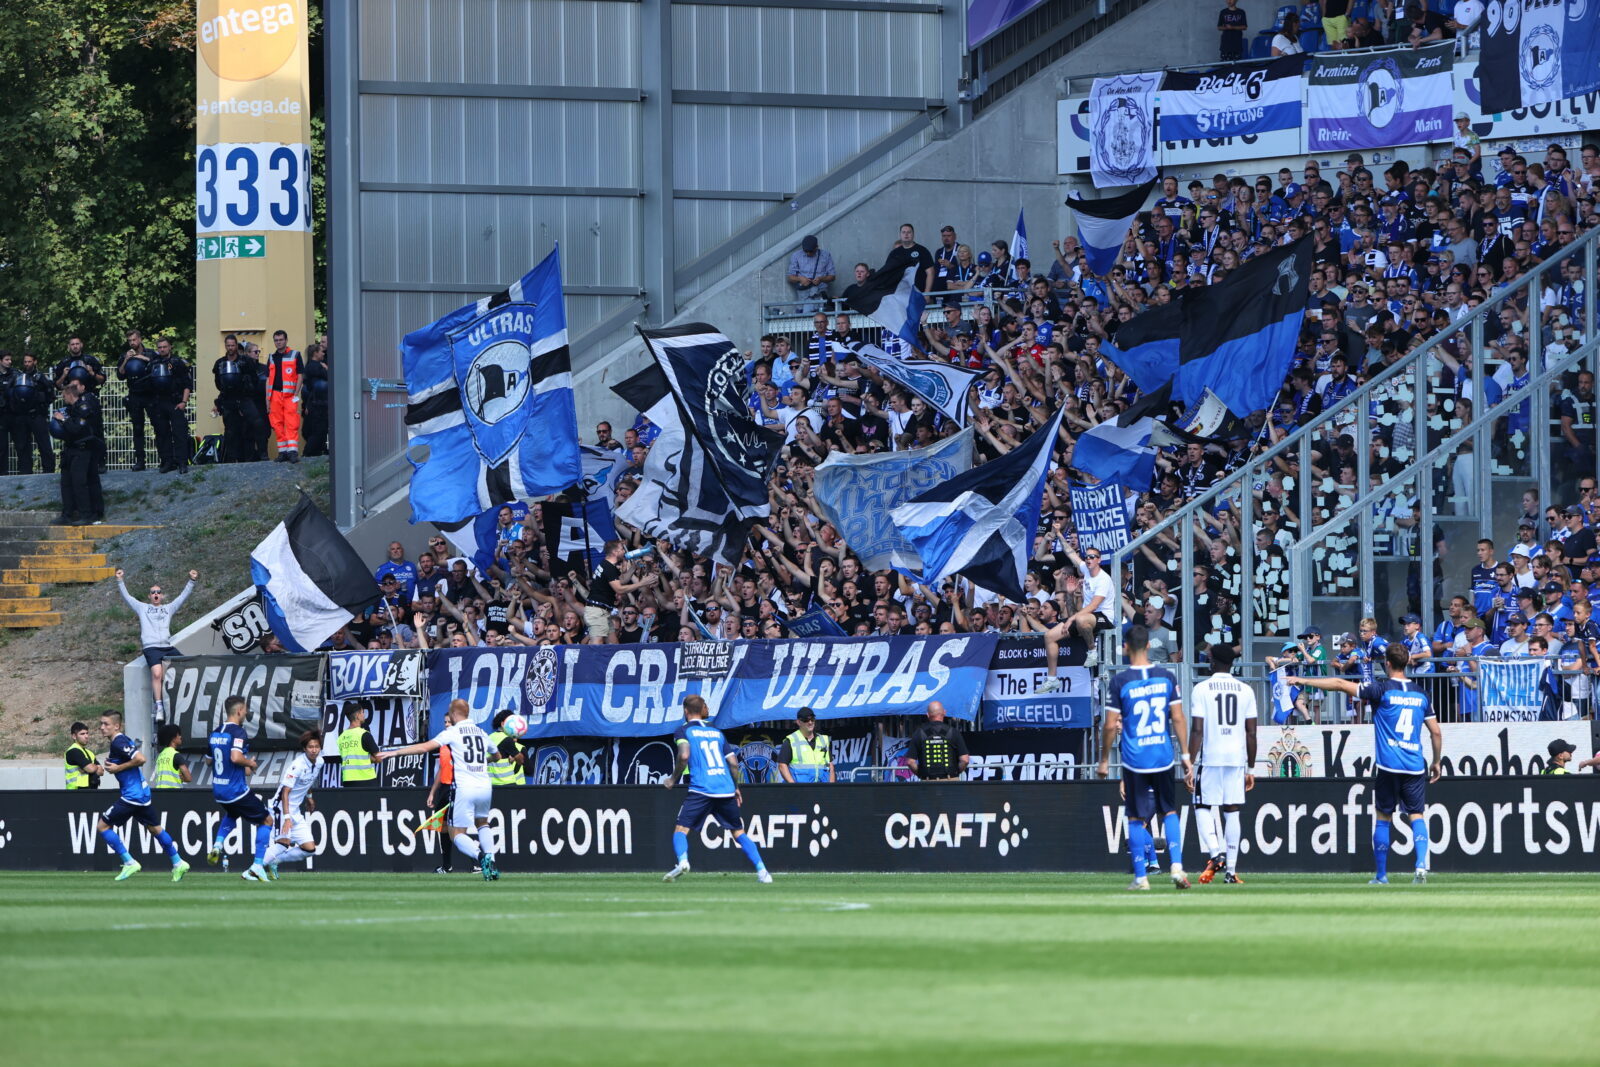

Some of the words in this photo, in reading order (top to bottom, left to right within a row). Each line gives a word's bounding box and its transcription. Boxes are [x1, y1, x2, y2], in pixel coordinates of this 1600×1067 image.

[202, 3, 294, 43] entega
[1315, 64, 1359, 77] Arminia
[1415, 56, 1441, 69] Fans
[1245, 69, 1267, 101] 6
[210, 97, 300, 117] entega.de
[1318, 128, 1351, 141] Rhein-
[1415, 119, 1442, 132] Main
[467, 311, 533, 347] ULTRAS
[1071, 484, 1121, 510] AVANTI
[1075, 506, 1125, 531] ULTRAS
[1079, 528, 1129, 553] ARMINIA
[715, 642, 730, 655] ALS
[998, 650, 1023, 659] BLOCK
[1023, 650, 1028, 658] 6
[331, 653, 390, 695] BOYS
[696, 655, 730, 669] AUFLAGE
[762, 636, 970, 710] ULTRAS
[449, 648, 583, 724] LOKL
[997, 673, 1028, 695] The
[1129, 683, 1167, 698] DARMSTADT
[1208, 682, 1242, 692] BIELEFELD
[163, 664, 293, 742] SPENGE
[997, 704, 1072, 723] BIELEFELD
[1214, 693, 1238, 726] 10
[1133, 697, 1167, 737] 23
[1395, 708, 1414, 741] 4
[213, 747, 224, 776] 8
[463, 735, 485, 764] 39
[700, 740, 724, 767] 11
[700, 814, 807, 850] CRAFT
[885, 812, 996, 849] CRAFT
